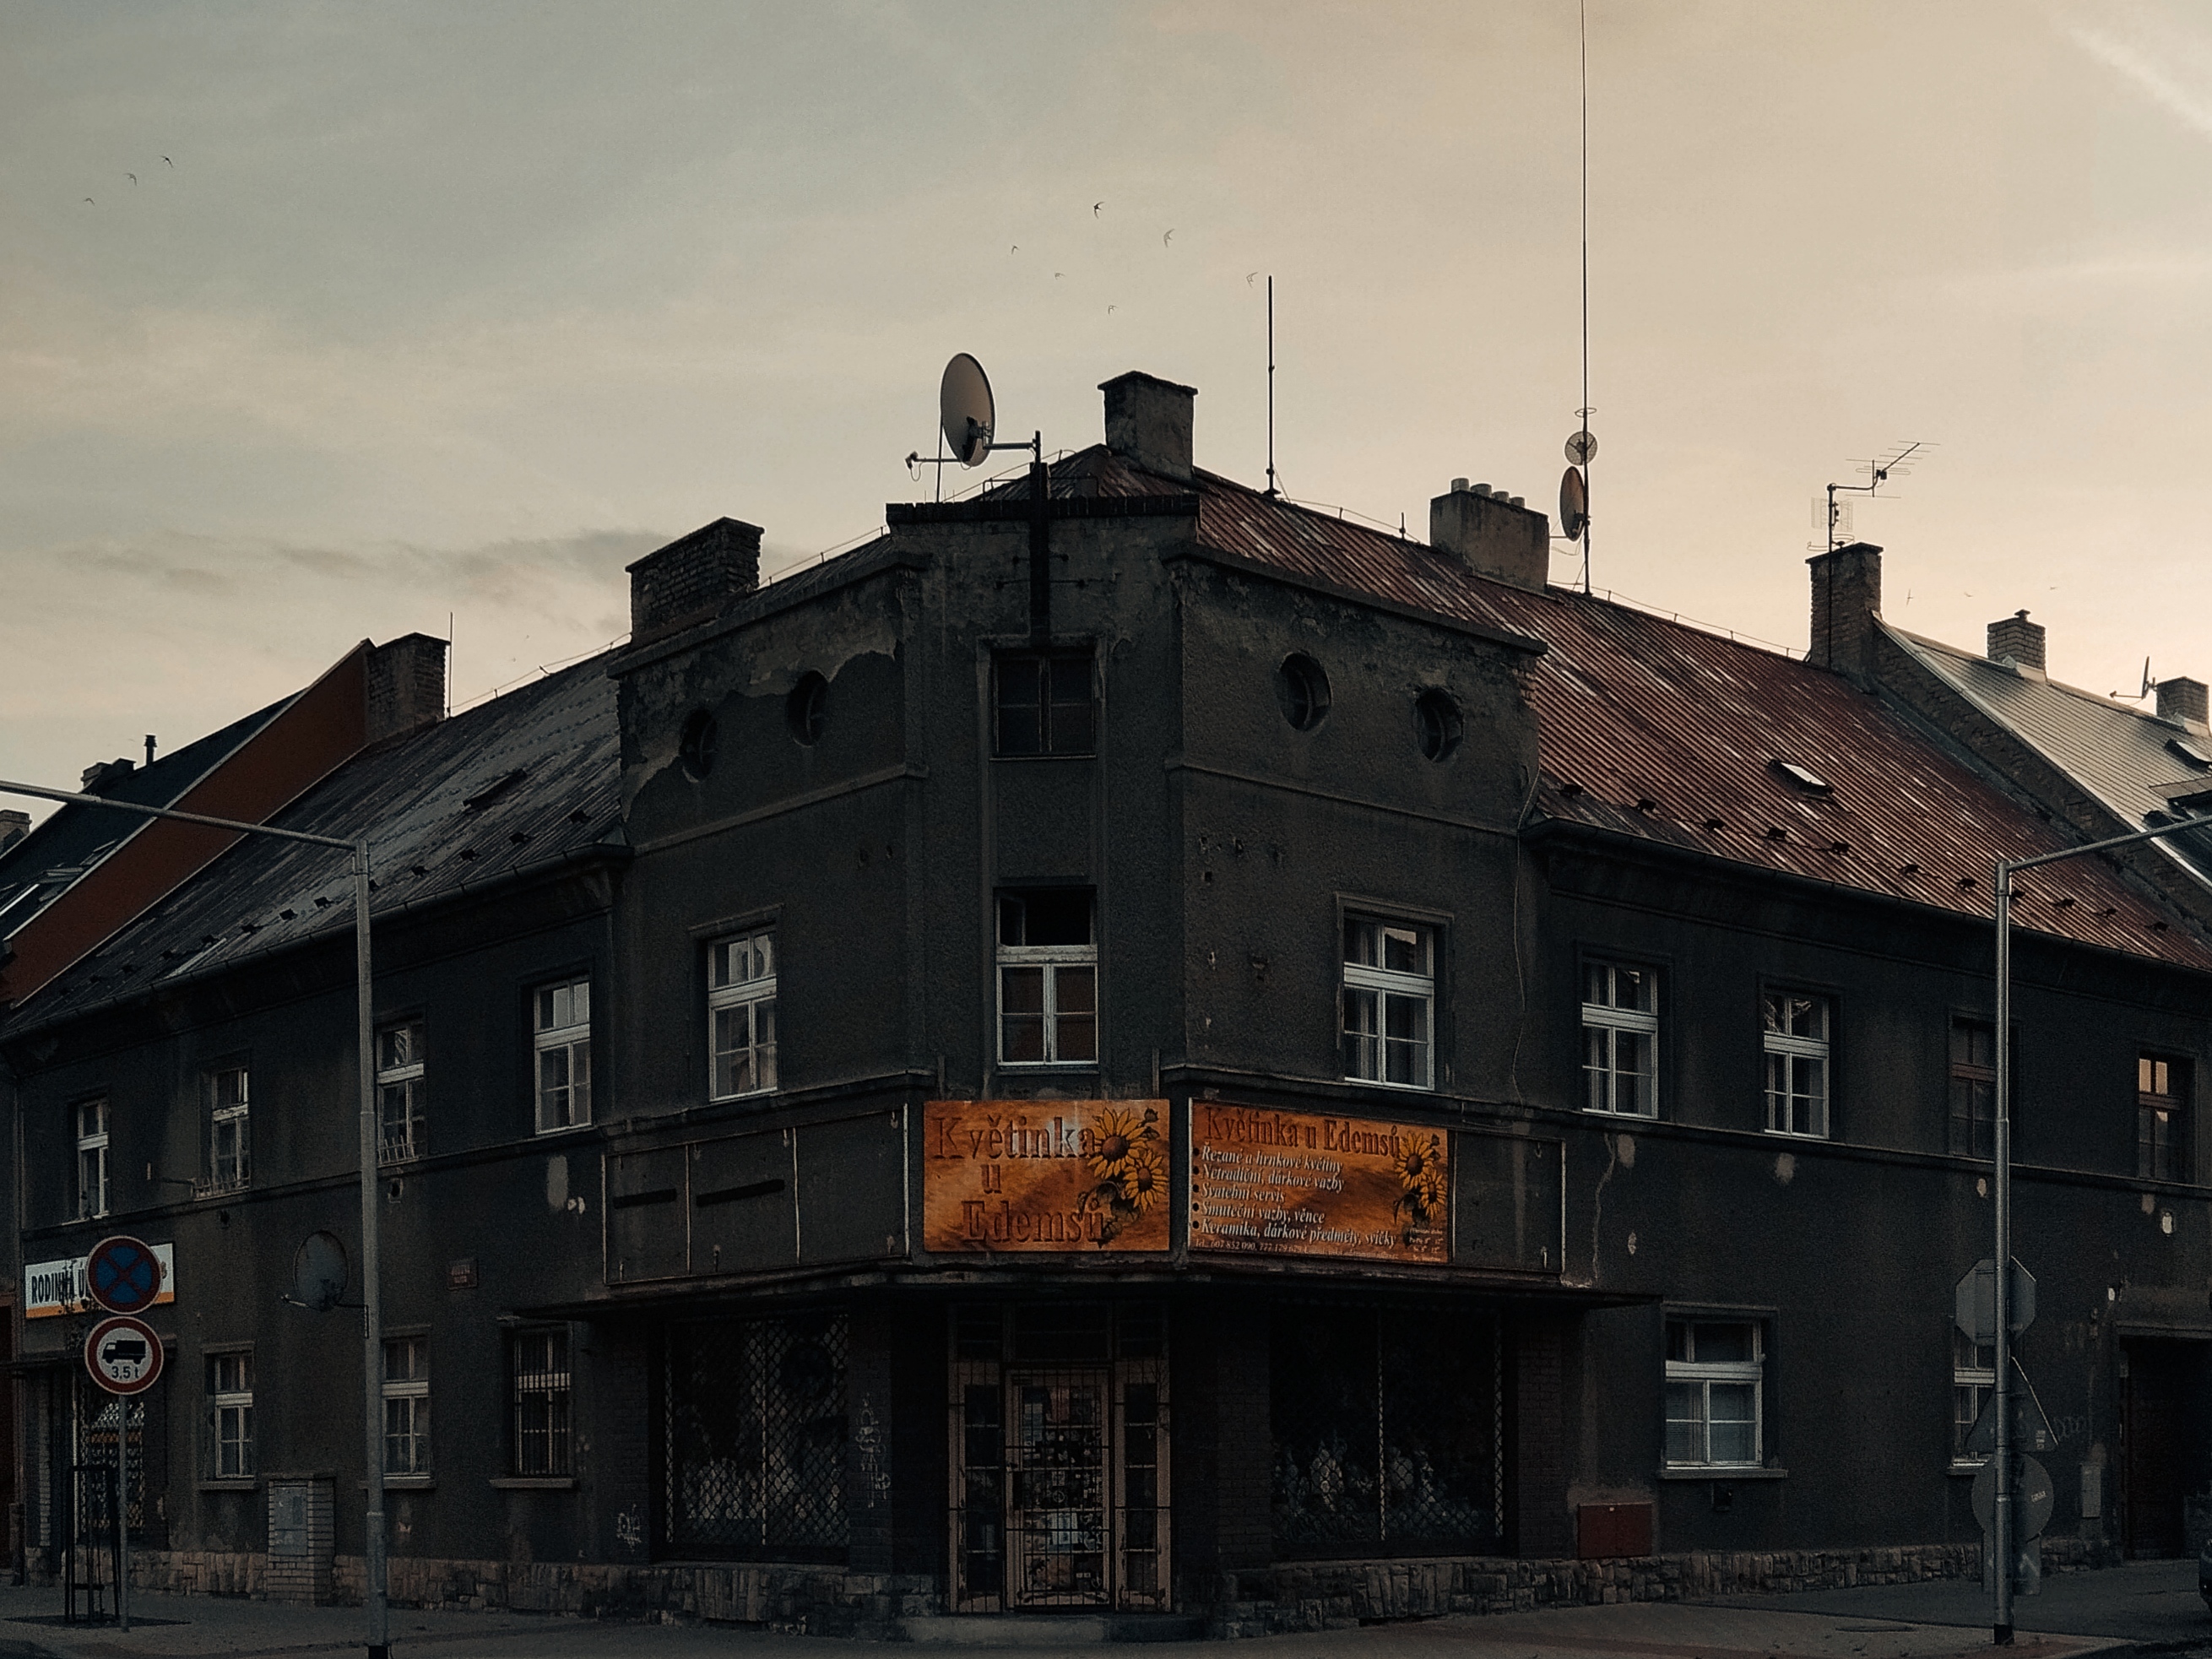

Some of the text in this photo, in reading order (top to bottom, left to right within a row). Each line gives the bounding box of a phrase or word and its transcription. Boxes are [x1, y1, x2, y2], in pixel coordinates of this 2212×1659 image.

[931, 1114, 1097, 1160] Květinka
[1204, 1106, 1400, 1158] Květinka u Edemsů
[1201, 1141, 1343, 1176] Řezané a hrnkové květiny
[981, 1164, 1002, 1195] u
[1201, 1163, 1346, 1194] Netradiční, dárkové vazby
[1201, 1181, 1286, 1204] Svatební servis
[962, 1196, 1107, 1244] Edemsů
[1201, 1200, 1326, 1225] Smuteční vazby, věnce
[1201, 1217, 1261, 1239] Keramika,
[1263, 1223, 1308, 1241] dárkové
[1309, 1225, 1363, 1247] předměty,
[1365, 1230, 1397, 1250] svíčky
[134, 1366, 141, 1380] t
